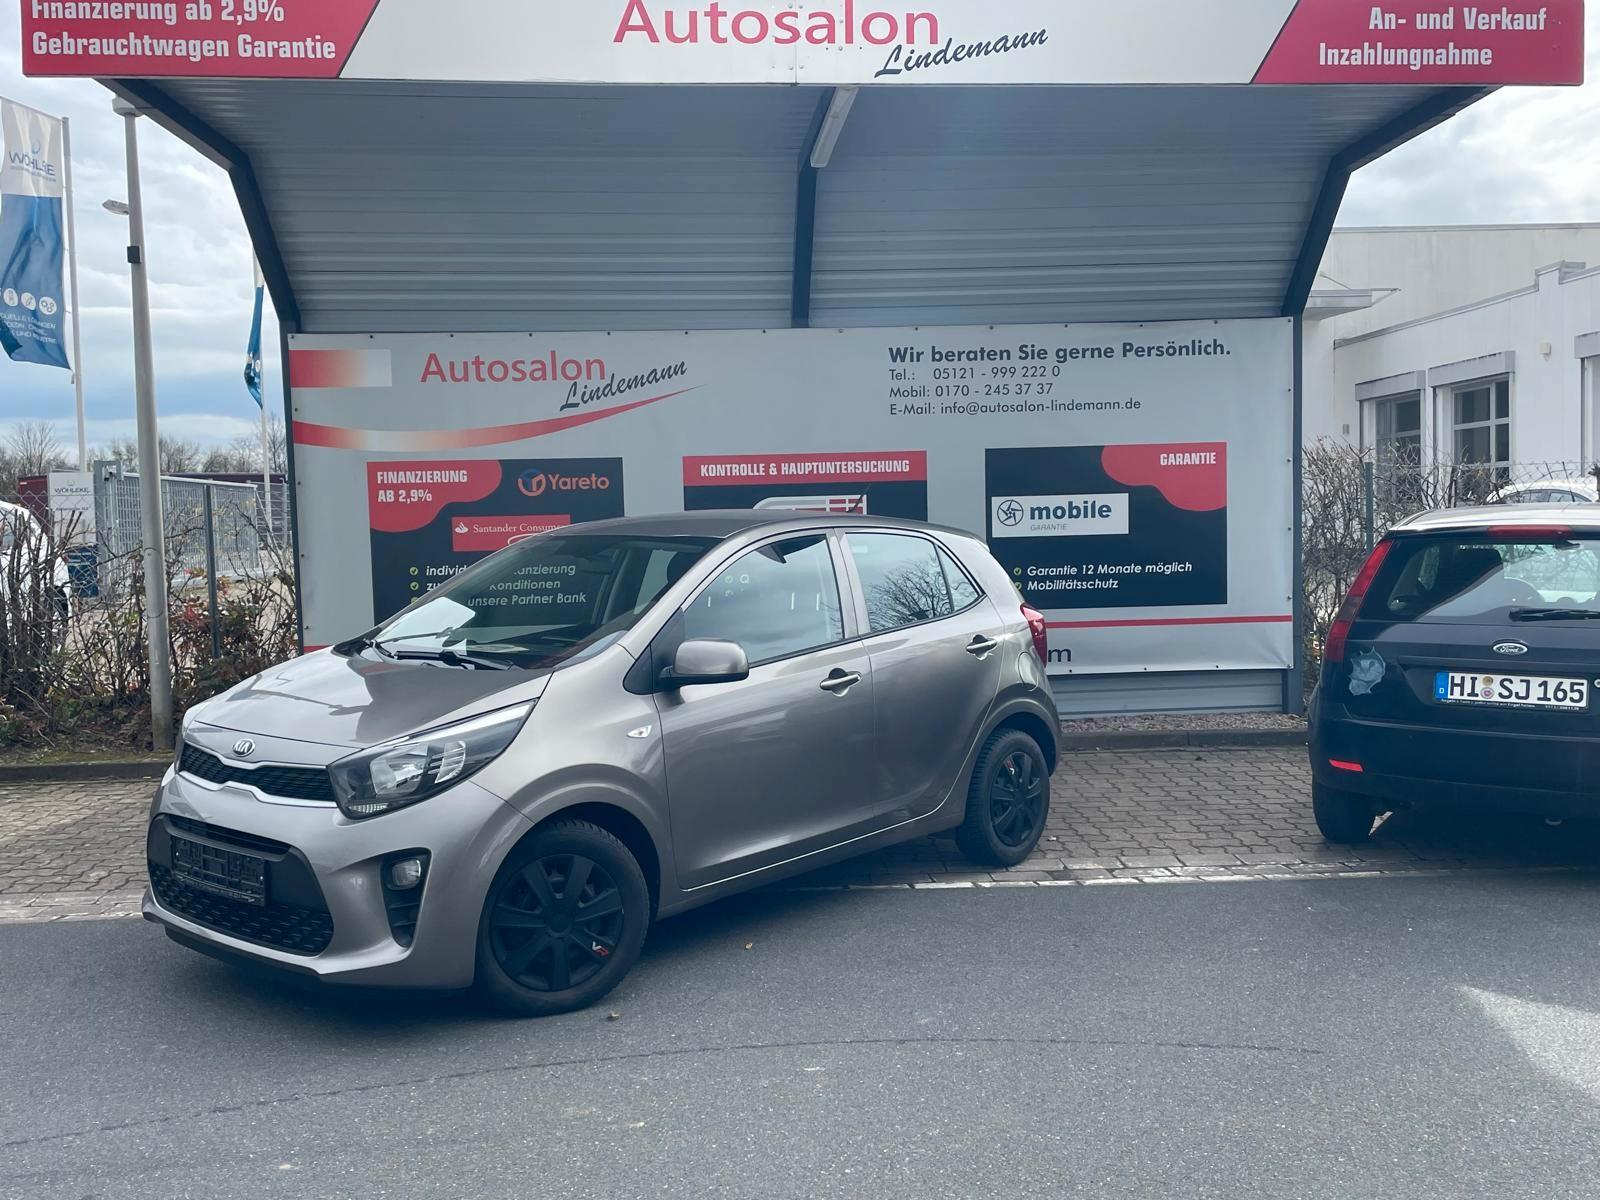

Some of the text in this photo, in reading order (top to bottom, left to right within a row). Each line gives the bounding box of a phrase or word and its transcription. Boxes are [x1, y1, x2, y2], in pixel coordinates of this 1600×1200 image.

[32, 0, 285, 25] Finanzierung ab 2,9%
[1369, 7, 1547, 30] An- und Verkauf
[613, 0, 939, 44] Autosalon
[32, 32, 336, 62] Gebrauchtwagen Garantie
[874, 28, 1048, 78] Lindemann
[1319, 42, 1492, 70] Inzahlungnahme
[888, 338, 1231, 363] Wir beraten Sie gerne Persönlich.
[420, 350, 605, 383] Autosalon
[889, 369, 915, 381] Tel.:
[933, 367, 975, 380] 05121
[991, 366, 1016, 379] 999
[1021, 366, 1047, 378] 222
[1052, 366, 1060, 378] 0
[560, 360, 687, 411] Lindemann
[889, 385, 930, 399] Mobil:
[935, 385, 970, 398] 0170
[984, 384, 1010, 397] 245
[1015, 382, 1032, 395] 37
[1036, 382, 1054, 394] 37
[890, 398, 1141, 416] E-Mail: info@autosalon-lindemann.de
[1160, 452, 1216, 466] GARANTIE
[377, 470, 467, 484] FINANZIERUNG
[701, 460, 910, 477] KONTROLLE & HAUPTUNTERSUCHUNG
[548, 473, 610, 490] Yareto
[378, 490, 432, 504] AB 2,9%
[1030, 500, 1112, 520] mobile
[473, 523, 517, 534] Santander
[1030, 523, 1067, 531] GARANTIE
[1027, 562, 1192, 577] Garantie 12 Monate möglich
[1027, 579, 1118, 591] Mobilitätsschutz
[467, 592, 586, 607] unsere Partner Bank
[1450, 676, 1479, 697] HI
[1498, 678, 1530, 700] SJ
[1537, 680, 1584, 703] 165
